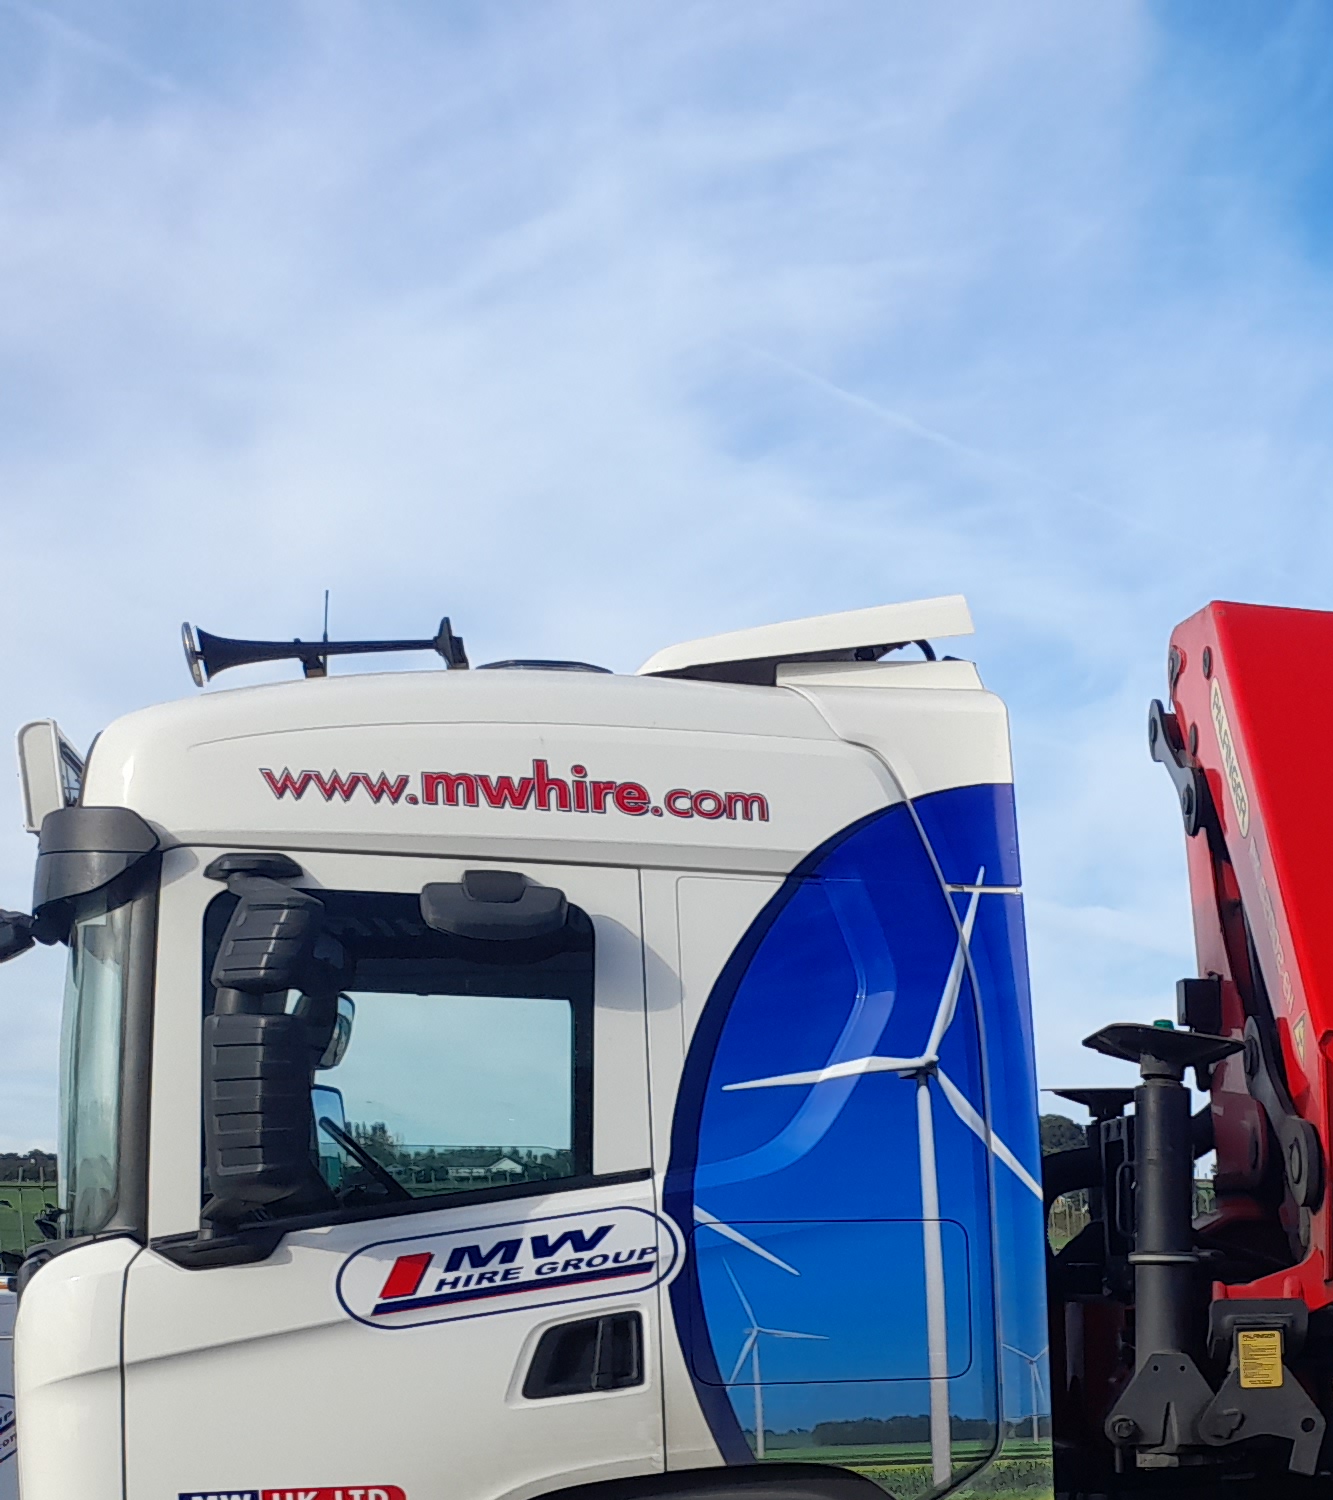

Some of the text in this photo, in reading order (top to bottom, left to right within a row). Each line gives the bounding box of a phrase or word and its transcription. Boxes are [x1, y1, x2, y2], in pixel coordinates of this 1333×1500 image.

[258, 758, 771, 822] www.mwhire.com
[434, 1245, 660, 1293] HIRE GROUP
[442, 1223, 616, 1274] MW
